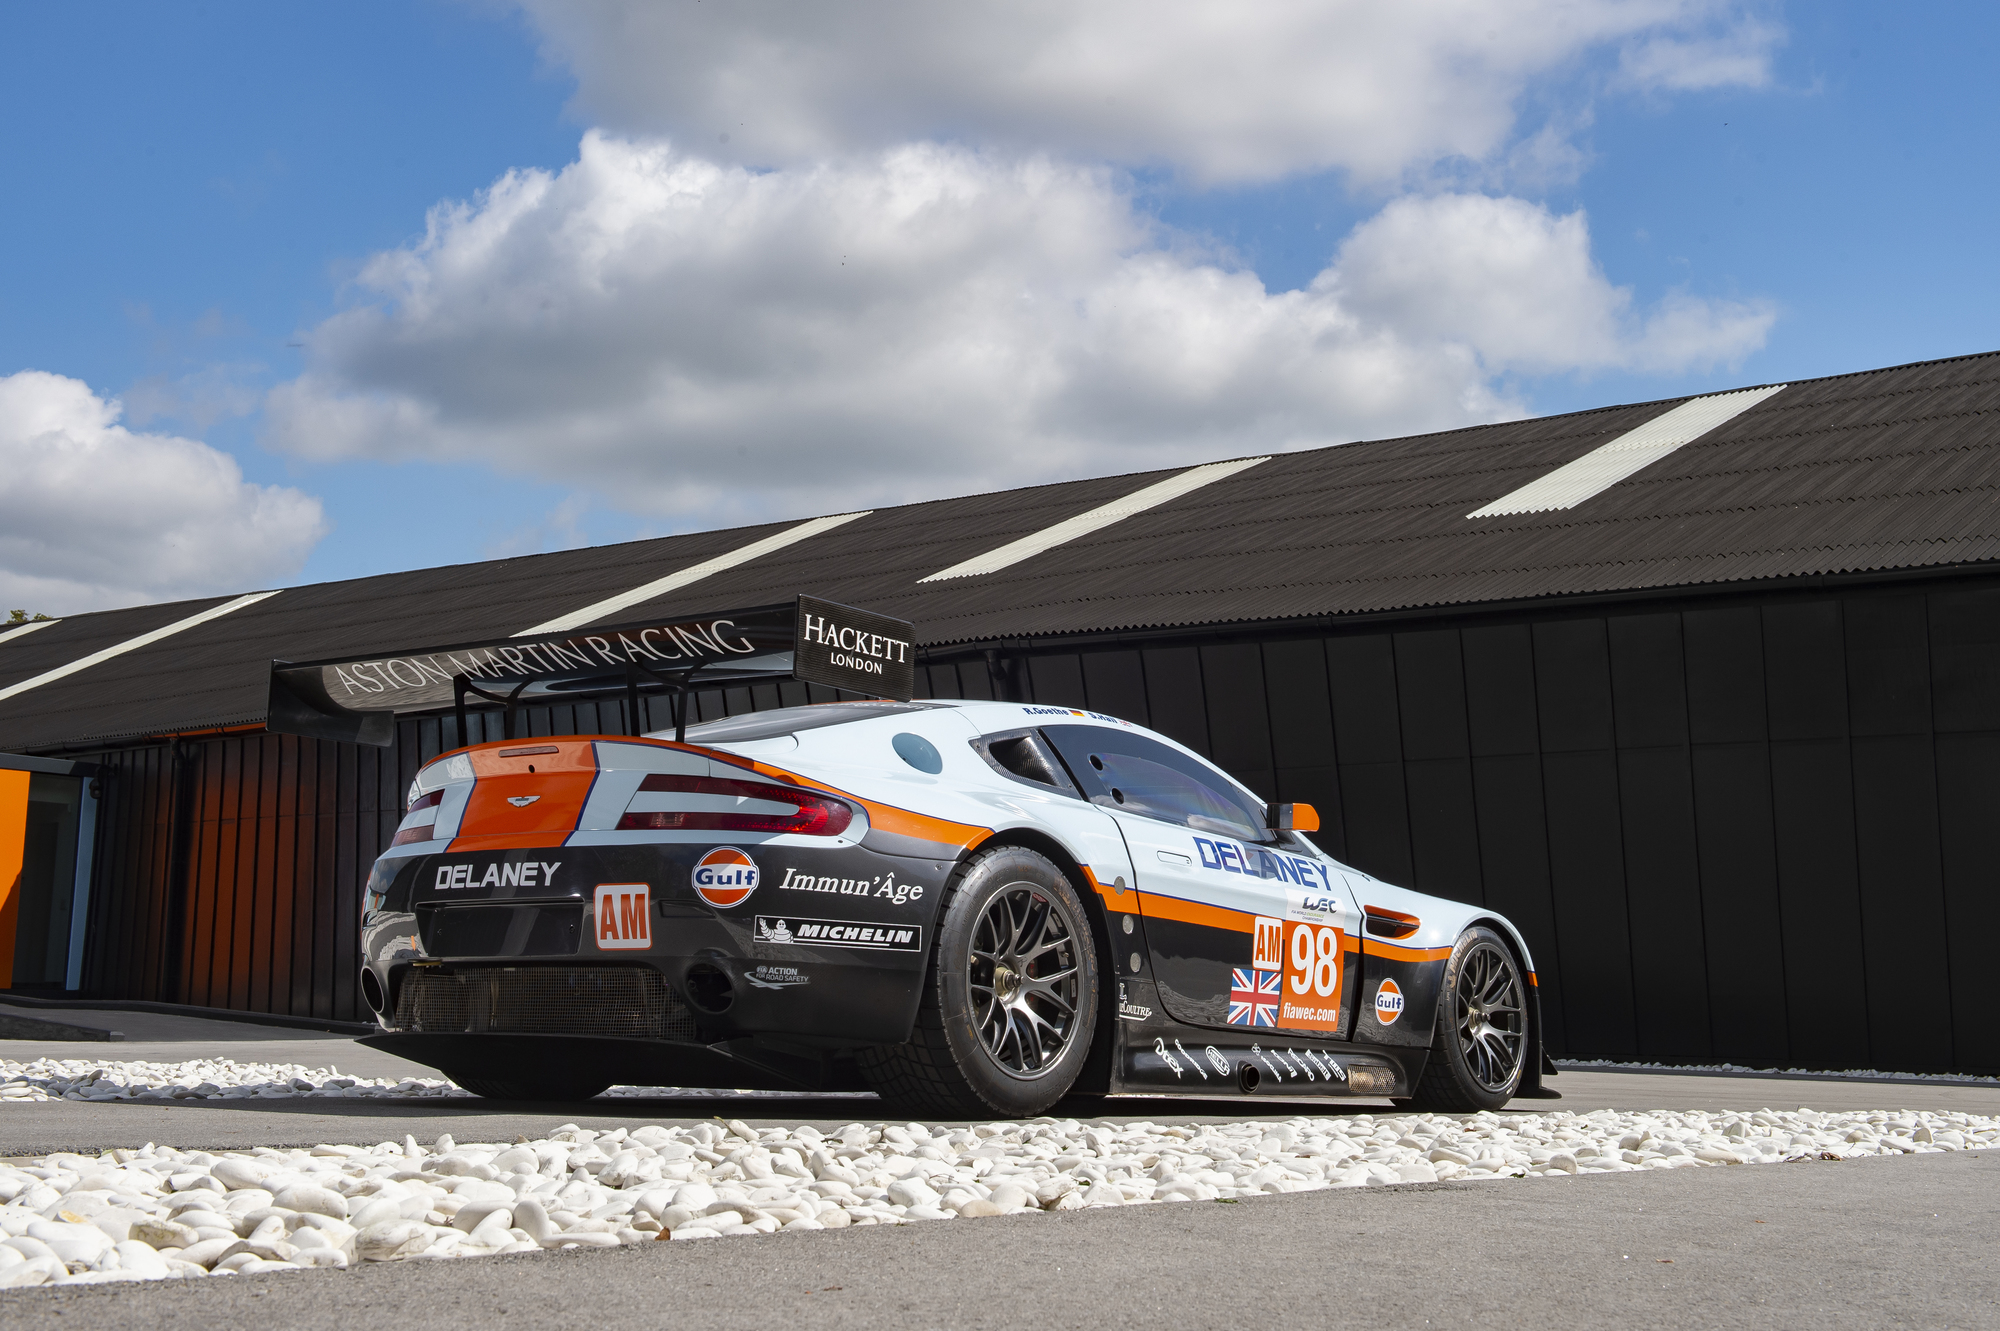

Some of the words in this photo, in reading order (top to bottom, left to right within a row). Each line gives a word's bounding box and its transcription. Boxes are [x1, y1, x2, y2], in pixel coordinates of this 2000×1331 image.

[804, 614, 909, 663] HACKETT
[335, 656, 454, 695] ASTON
[447, 639, 597, 681] MARTIN
[585, 619, 755, 663] RACING
[830, 652, 882, 675] LONDON
[435, 862, 561, 889] DELANEY
[1193, 836, 1331, 891] DELANEY
[695, 868, 756, 886] Gulf
[600, 893, 648, 940] AM
[1302, 897, 1337, 913] WEC
[797, 924, 914, 943] MICHELIN
[1255, 924, 1281, 963] AM
[768, 967, 798, 975] ACTION
[1290, 924, 1337, 997] 98
[1283, 1002, 1336, 1022] fiawec.com
[1376, 995, 1402, 1009] Gulf
